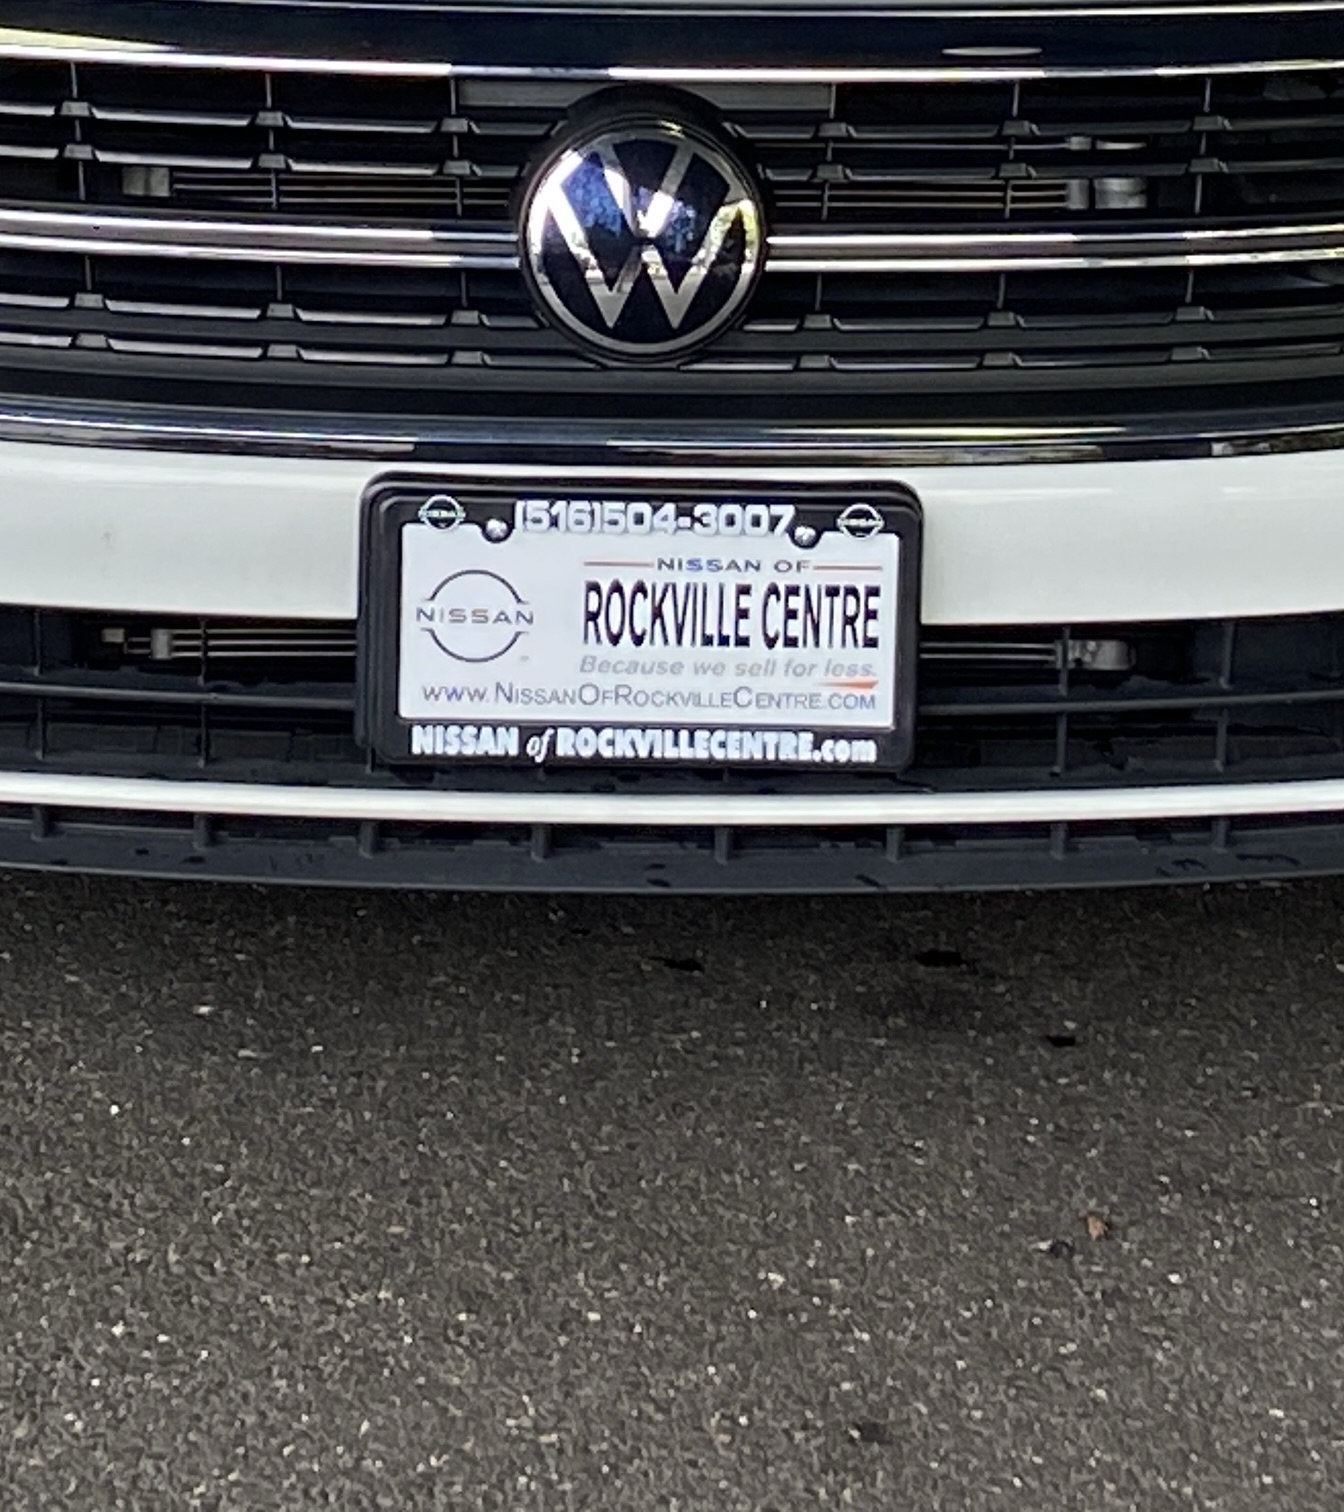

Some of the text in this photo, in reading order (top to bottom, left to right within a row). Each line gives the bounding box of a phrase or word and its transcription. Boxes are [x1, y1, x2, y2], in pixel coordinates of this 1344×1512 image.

[657, 557, 810, 573] NISSAN OF
[416, 607, 534, 626] NISSAN
[584, 579, 881, 650] ROCKVILLE CENTRE
[579, 654, 684, 676] Because
[693, 661, 726, 677] we
[734, 658, 777, 677] sell
[783, 658, 818, 678] for
[411, 725, 878, 764] NISSAN of ROCKVILLECENTRE.com
